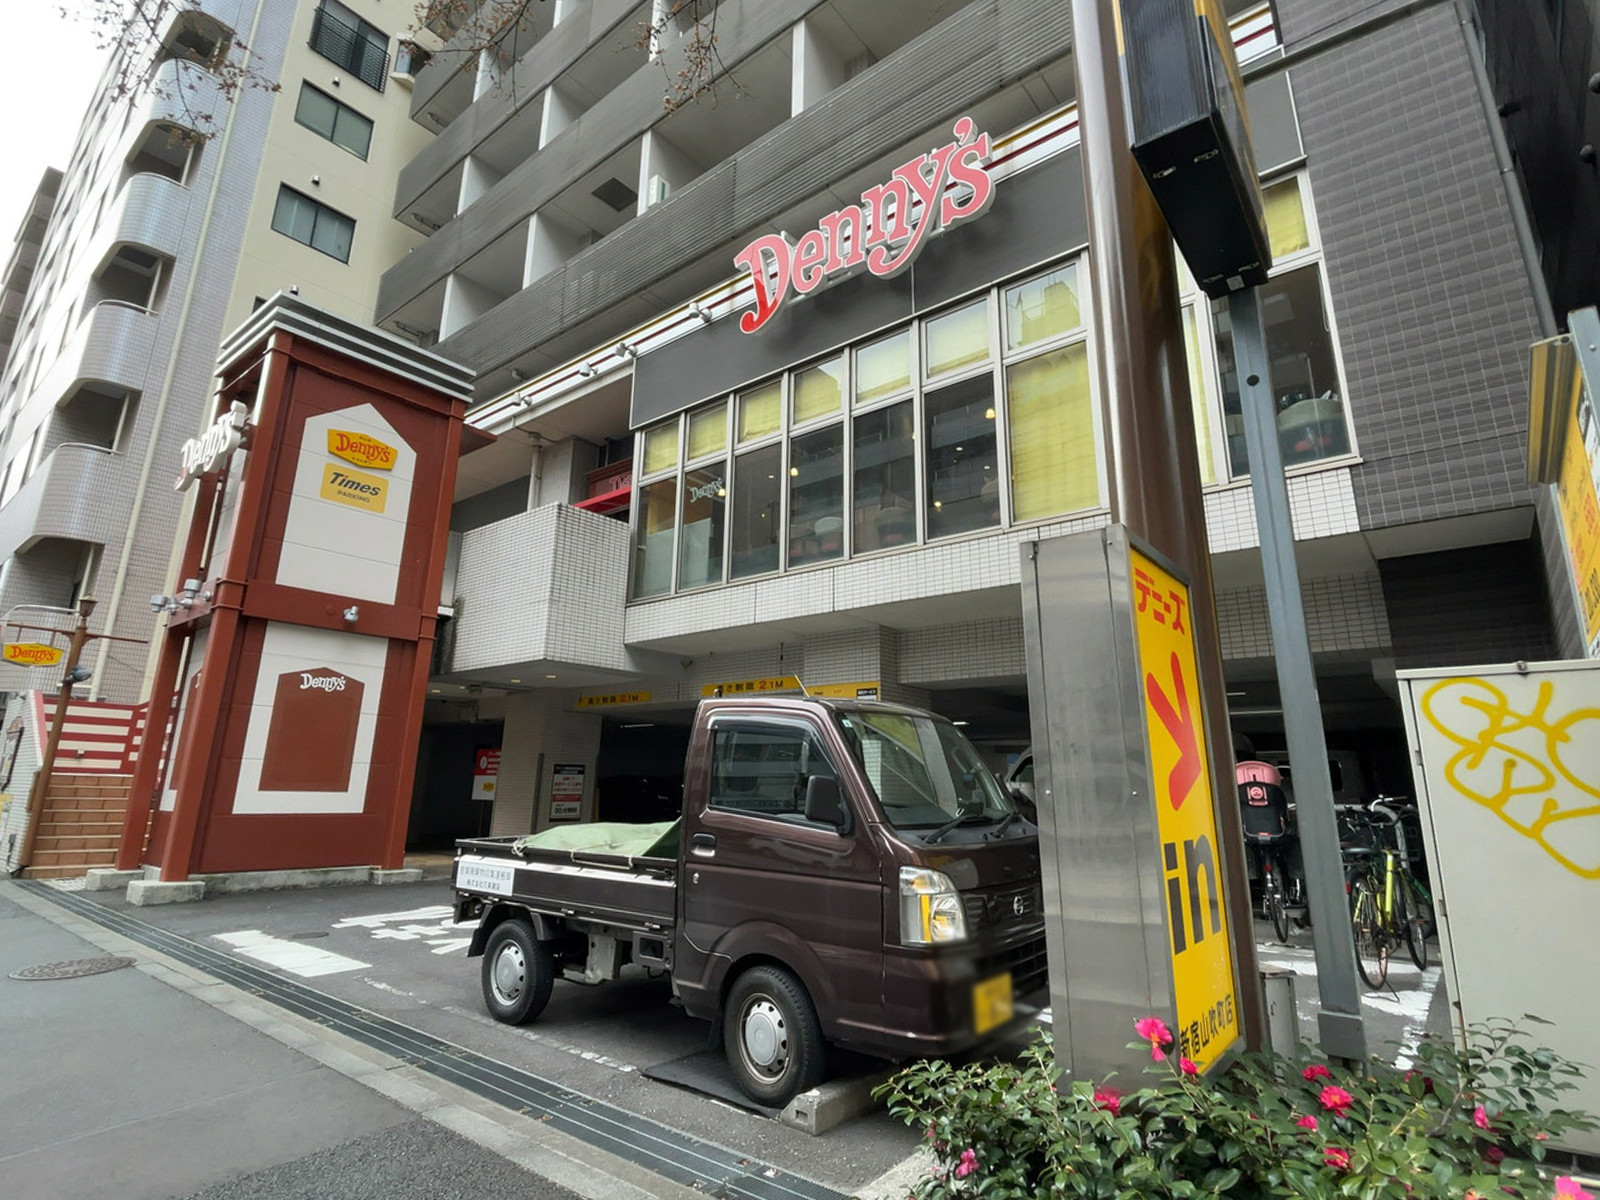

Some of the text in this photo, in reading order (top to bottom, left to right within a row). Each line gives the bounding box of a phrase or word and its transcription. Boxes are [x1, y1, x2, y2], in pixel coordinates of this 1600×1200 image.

[733, 116, 995, 334] Denny's
[336, 432, 391, 463] Denny's
[329, 471, 381, 497] Times
[337, 490, 371, 503] PARKING
[1135, 566, 1186, 636] デニーズ
[9, 645, 56, 662] Denny's
[299, 673, 347, 693] Denny's
[1163, 833, 1222, 956] in
[1179, 993, 1234, 1061] 新宿山吹町店
